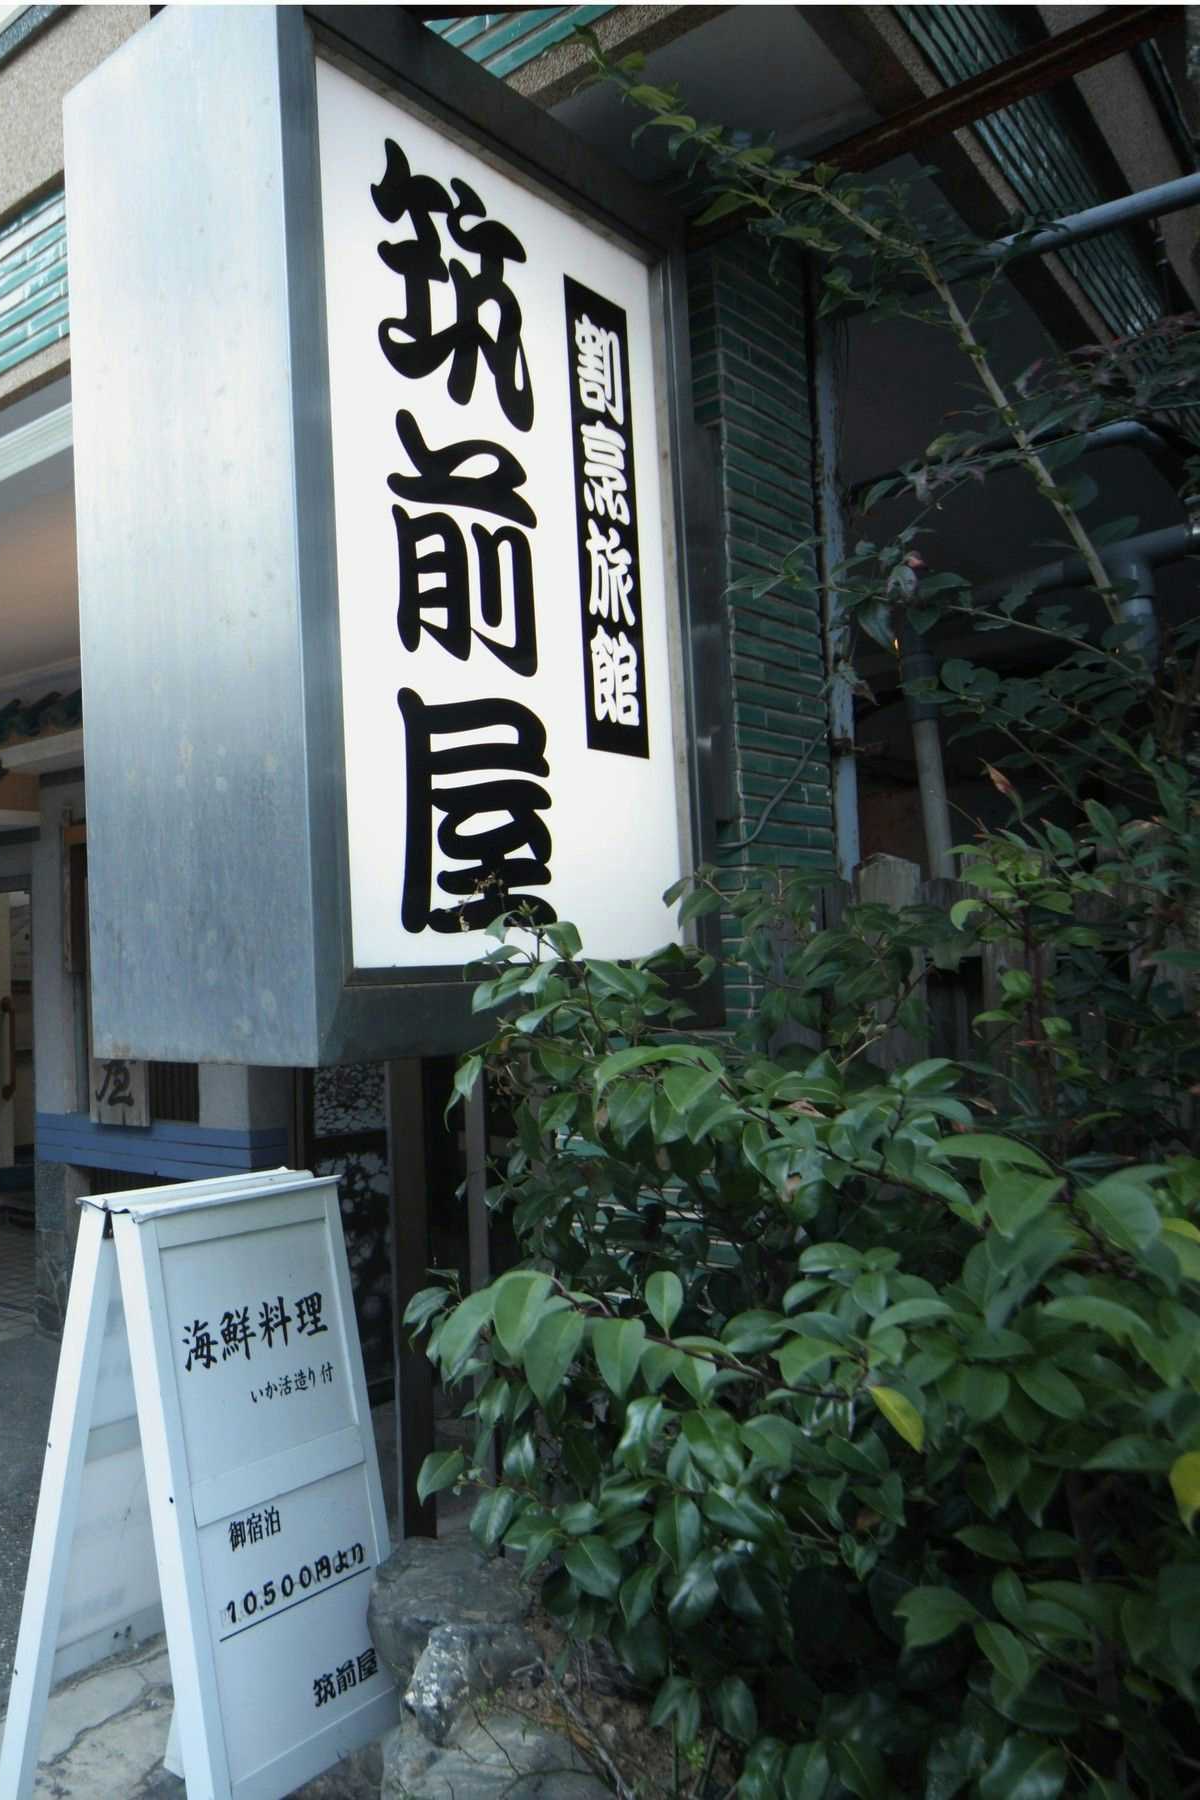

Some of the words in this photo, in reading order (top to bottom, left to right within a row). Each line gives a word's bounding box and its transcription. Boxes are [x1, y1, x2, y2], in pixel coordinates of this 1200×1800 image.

[371, 138, 557, 935] 筑前屋
[575, 313, 640, 727] 割烹旅館
[182, 1291, 329, 1372] 海鮮料理
[228, 1505, 281, 1551] 御宿泊
[313, 1648, 379, 1707] 筑前屋
